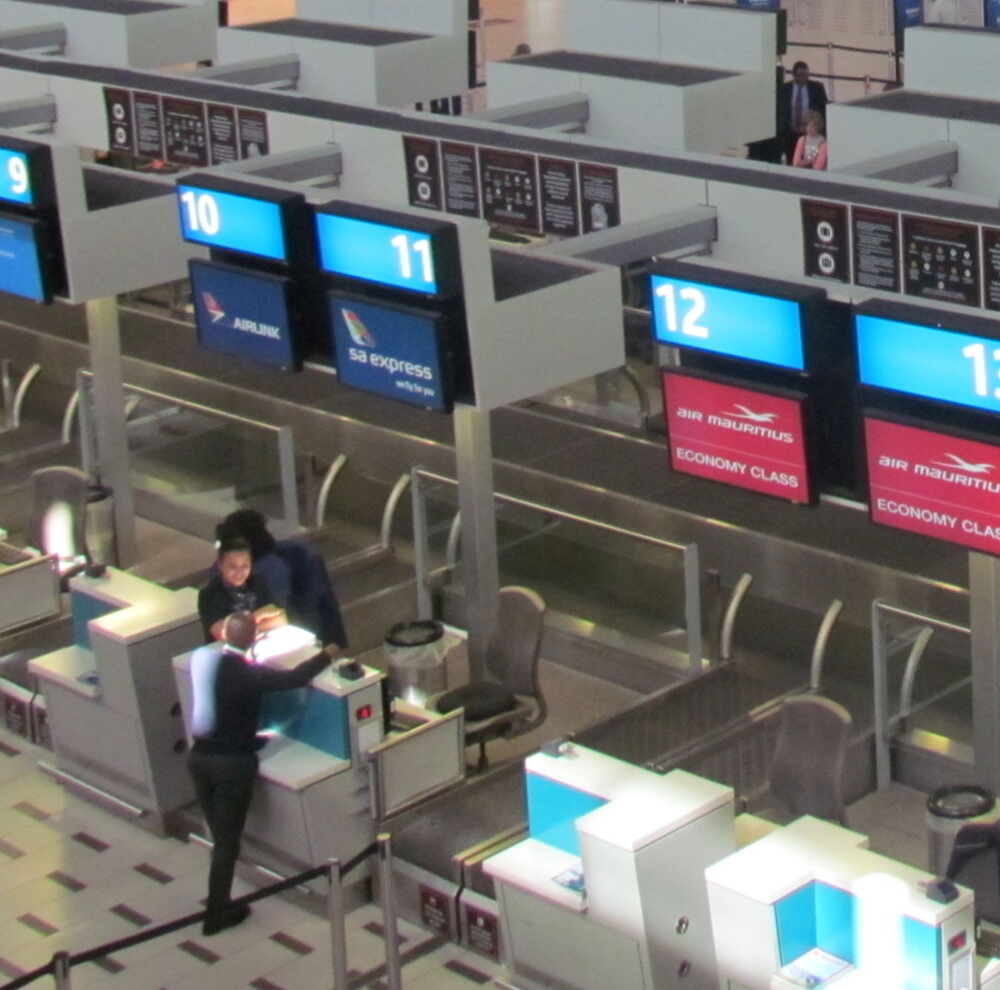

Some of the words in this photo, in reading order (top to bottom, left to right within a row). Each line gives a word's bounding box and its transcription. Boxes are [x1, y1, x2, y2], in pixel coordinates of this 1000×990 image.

[8, 156, 29, 194] 9
[180, 190, 220, 235] 10
[391, 234, 435, 283] 11
[233, 317, 281, 340] AIRLINK
[655, 283, 710, 339] 12
[349, 347, 367, 363] sa
[370, 353, 433, 380] express
[676, 447, 747, 475] ECONOMY
[751, 466, 799, 488] CLASS
[877, 498, 957, 529] ECONOMY
